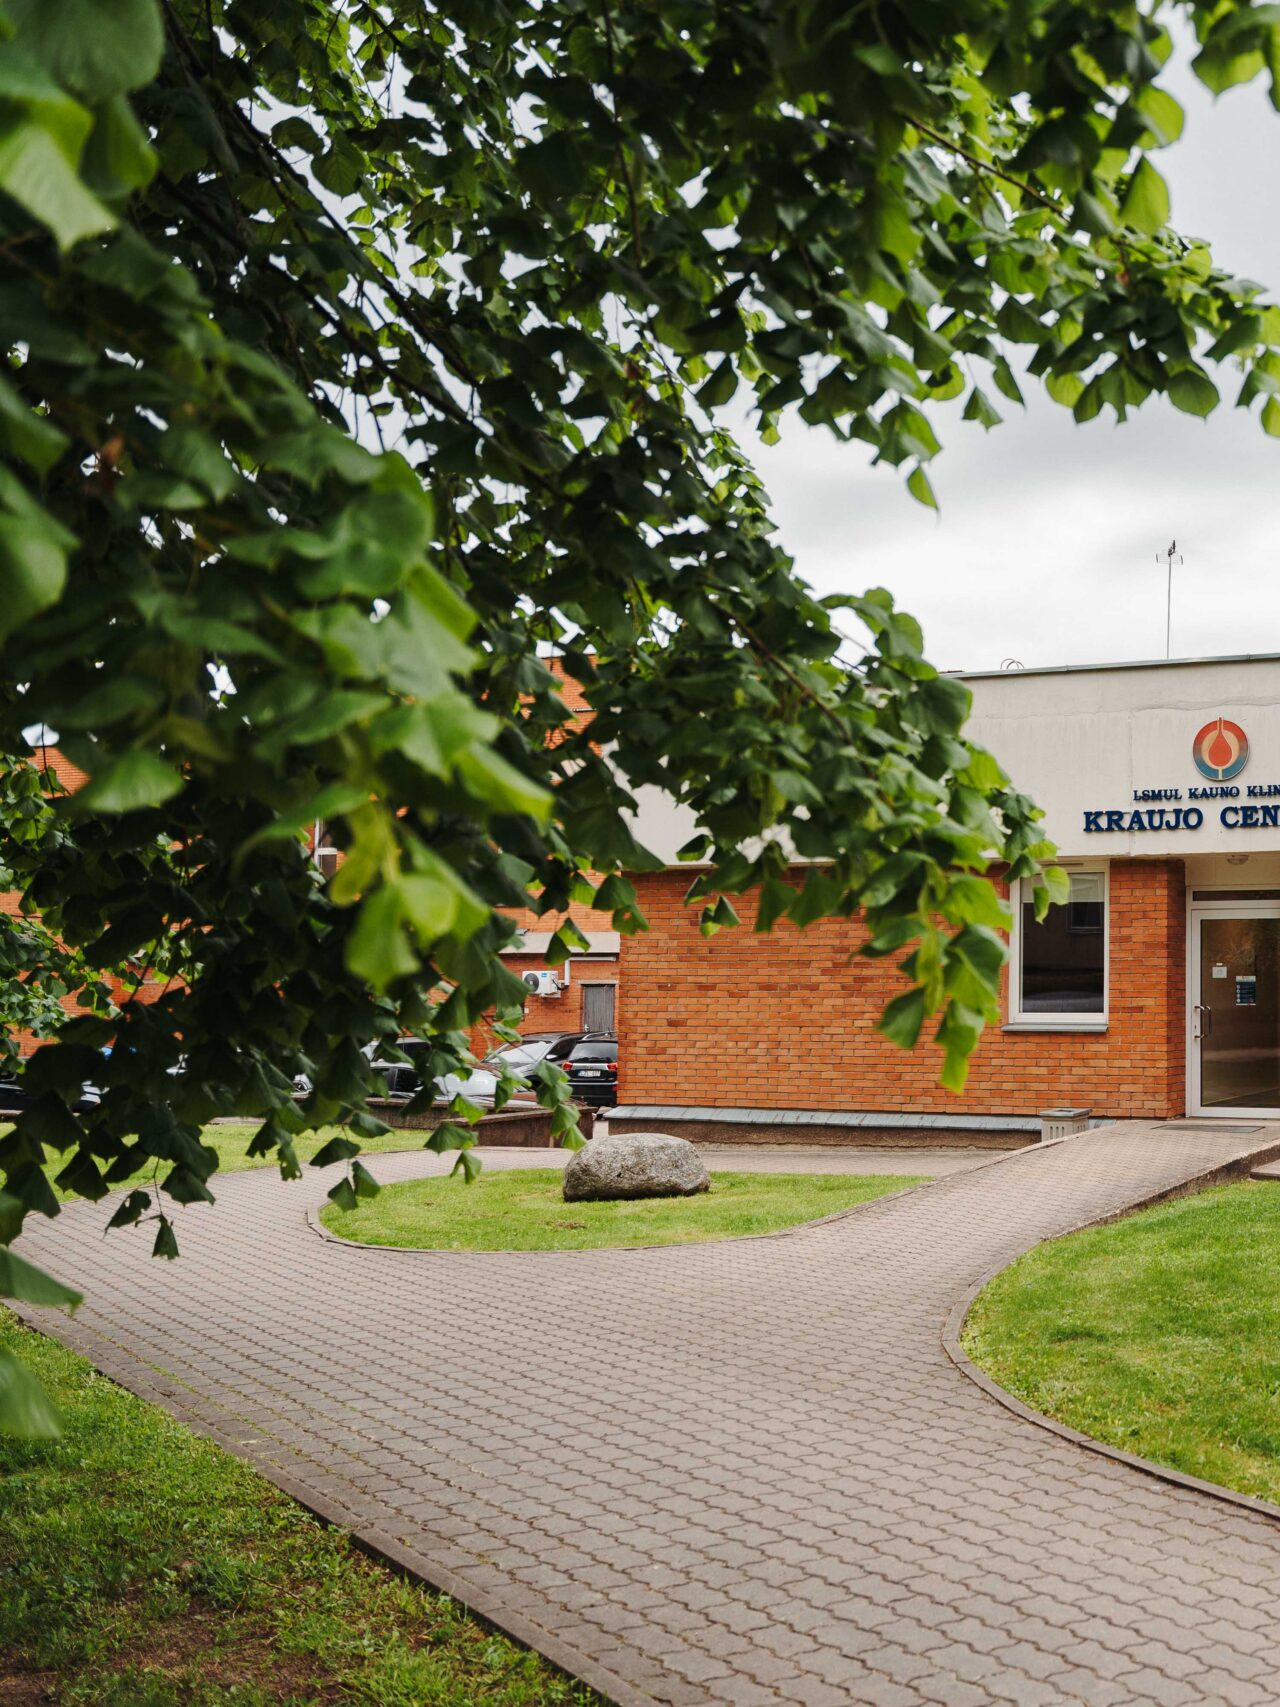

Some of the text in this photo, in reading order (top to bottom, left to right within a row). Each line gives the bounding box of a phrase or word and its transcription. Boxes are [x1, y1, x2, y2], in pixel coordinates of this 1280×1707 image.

[1133, 788, 1182, 801] LSMUL
[1188, 786, 1240, 799] KAUNO
[1083, 808, 1203, 832] KRAUJO
